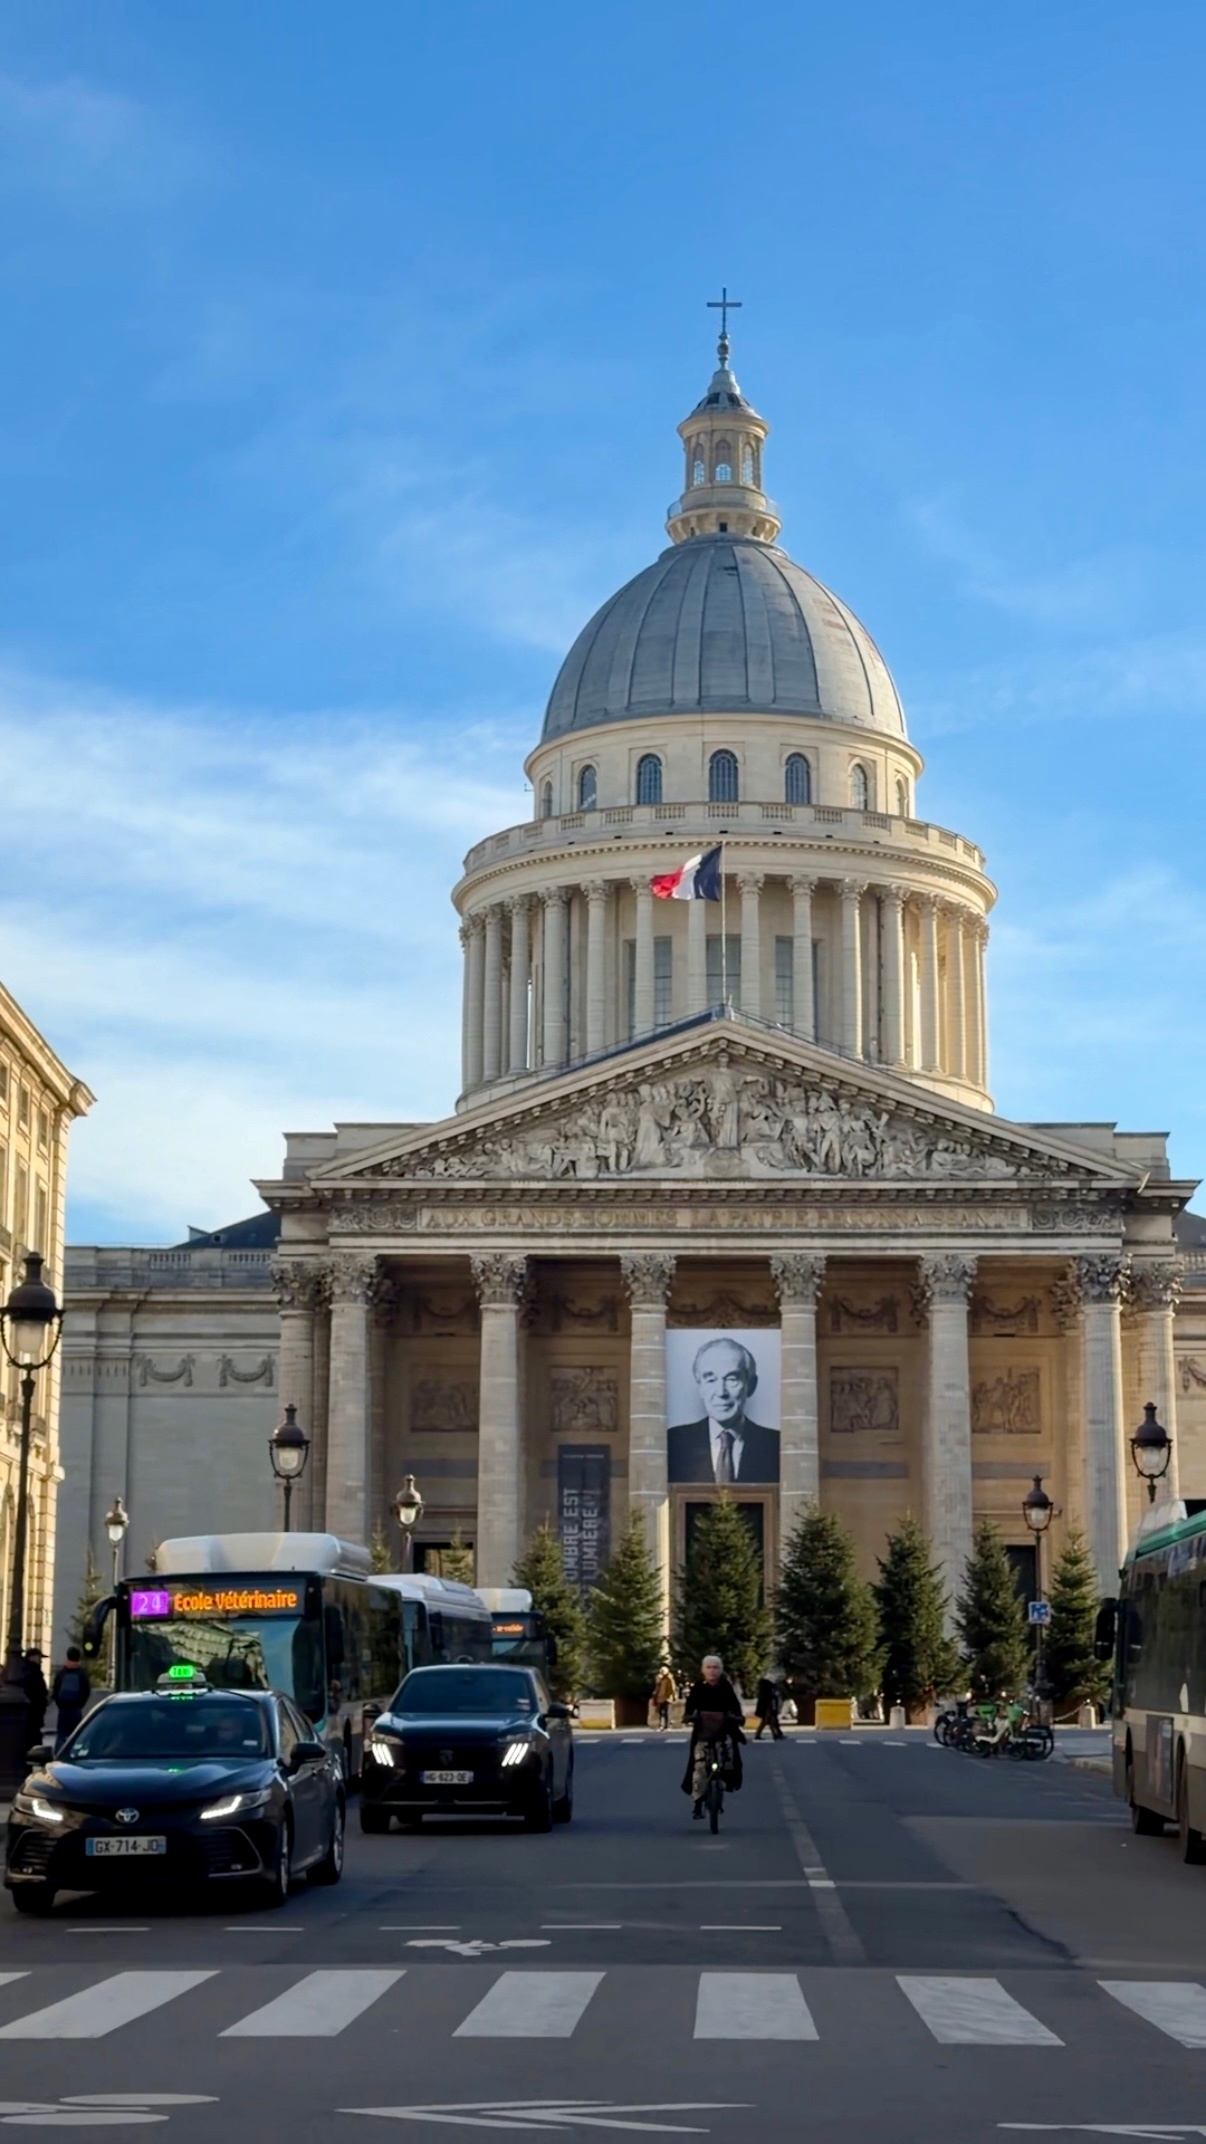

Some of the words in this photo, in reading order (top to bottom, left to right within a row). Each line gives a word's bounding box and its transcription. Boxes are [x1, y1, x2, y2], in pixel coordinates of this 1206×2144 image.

[425, 1208, 477, 1227] AUX
[481, 1208, 575, 1227] GRANDS
[727, 1208, 808, 1227] PATRIE
[563, 1487, 579, 1517] EST
[215, 1589, 297, 1610] Vétérinaire
